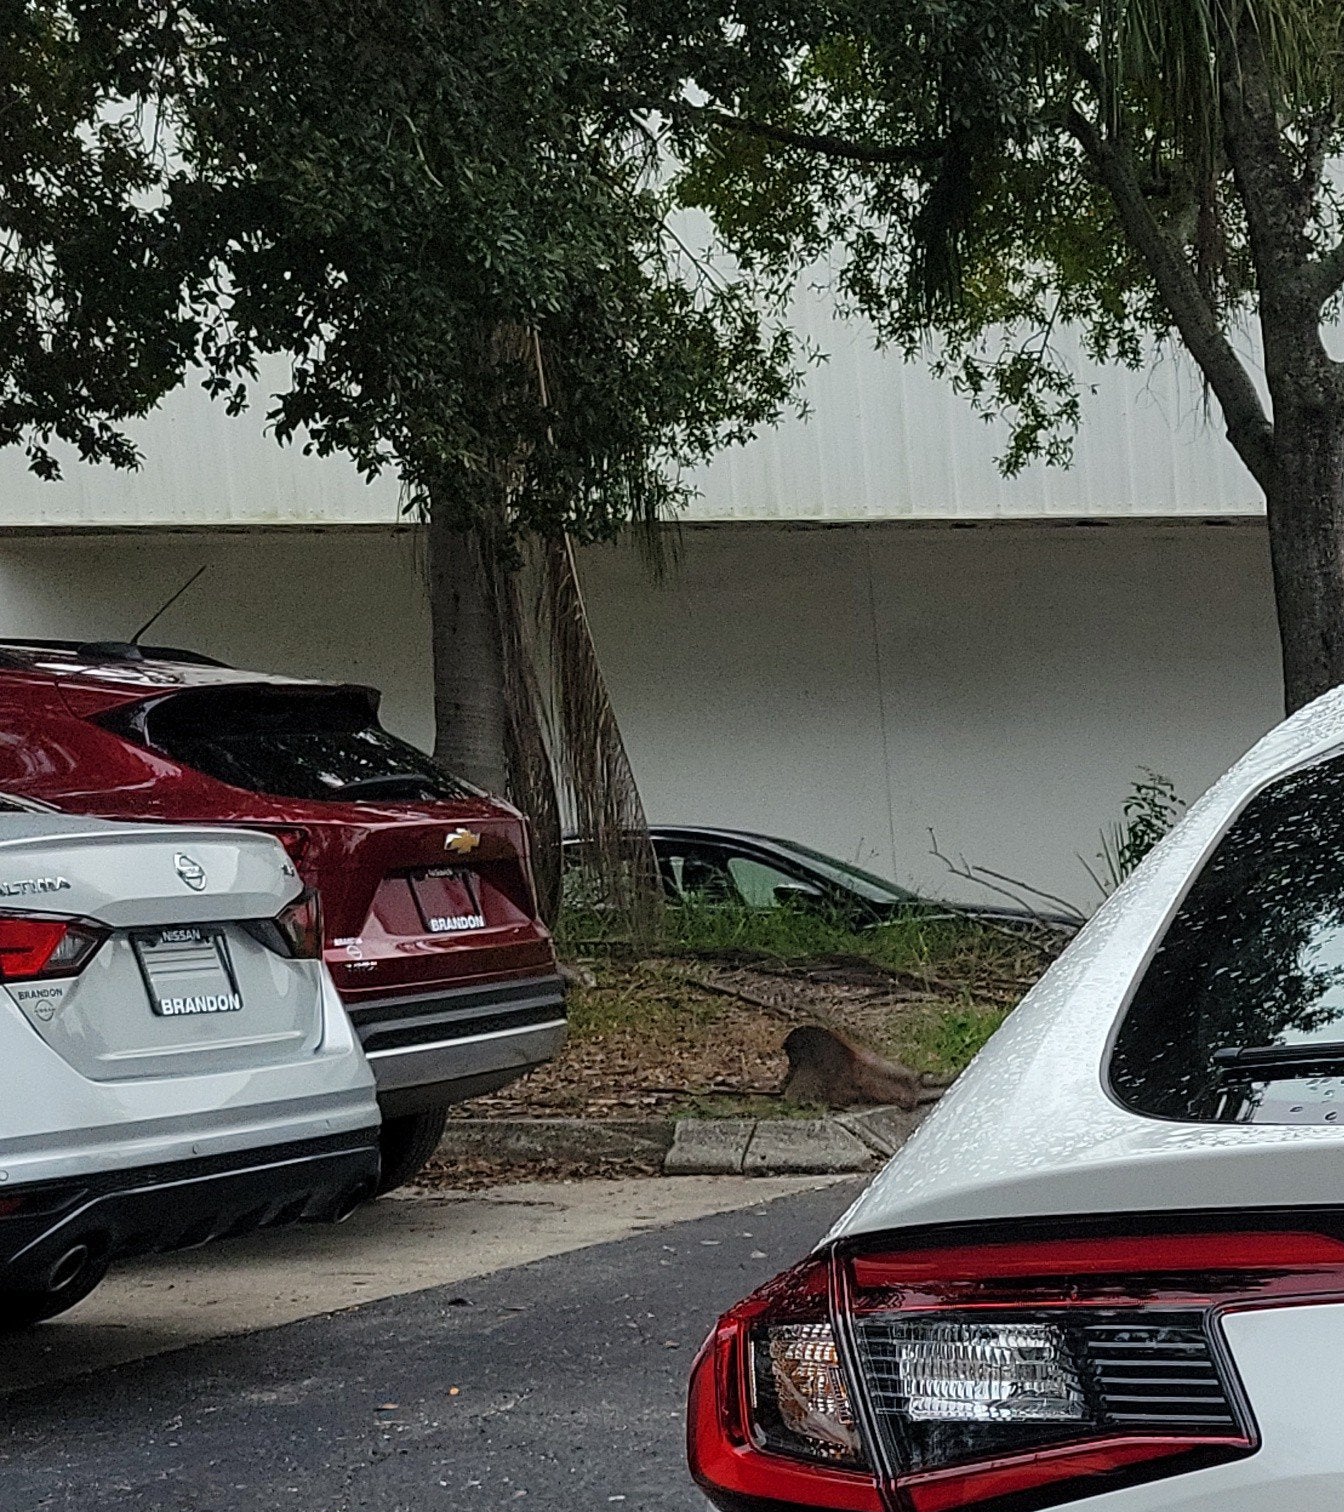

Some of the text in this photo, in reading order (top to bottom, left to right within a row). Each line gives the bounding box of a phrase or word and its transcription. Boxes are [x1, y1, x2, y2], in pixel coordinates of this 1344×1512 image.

[430, 915, 485, 932] BRANDON
[161, 928, 201, 943] NISSAN
[18, 988, 63, 1001] BRANDON
[160, 993, 242, 1016] BRANDON
